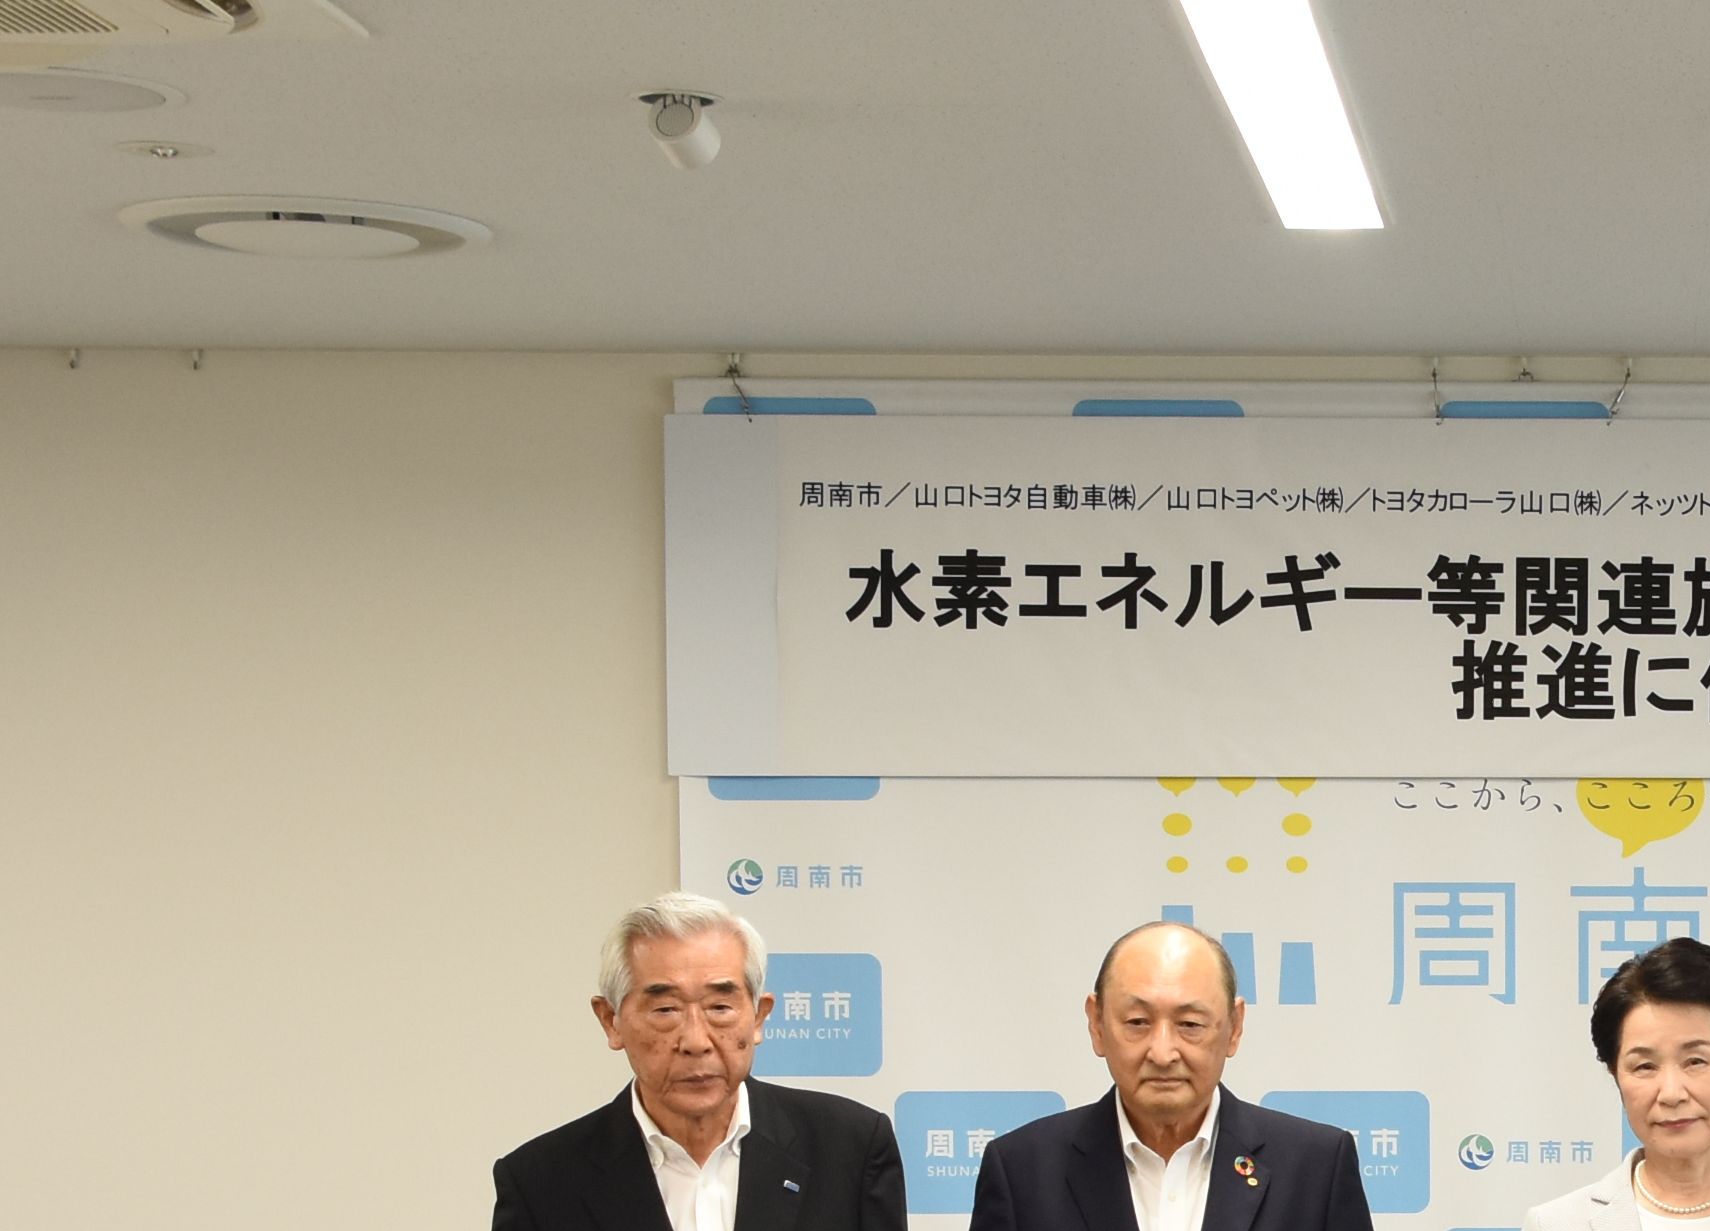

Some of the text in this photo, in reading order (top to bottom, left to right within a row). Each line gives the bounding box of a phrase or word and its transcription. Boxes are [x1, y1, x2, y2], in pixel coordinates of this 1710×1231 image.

[776, 865, 863, 888] 周南市
[767, 991, 851, 1021] 南市
[765, 1028, 852, 1039] UNAN CITY
[926, 1129, 996, 1158] 周南
[1507, 1140, 1594, 1164] 周南市
[927, 1166, 979, 1177] SHUNA
[1364, 1165, 1399, 1176] CITY
